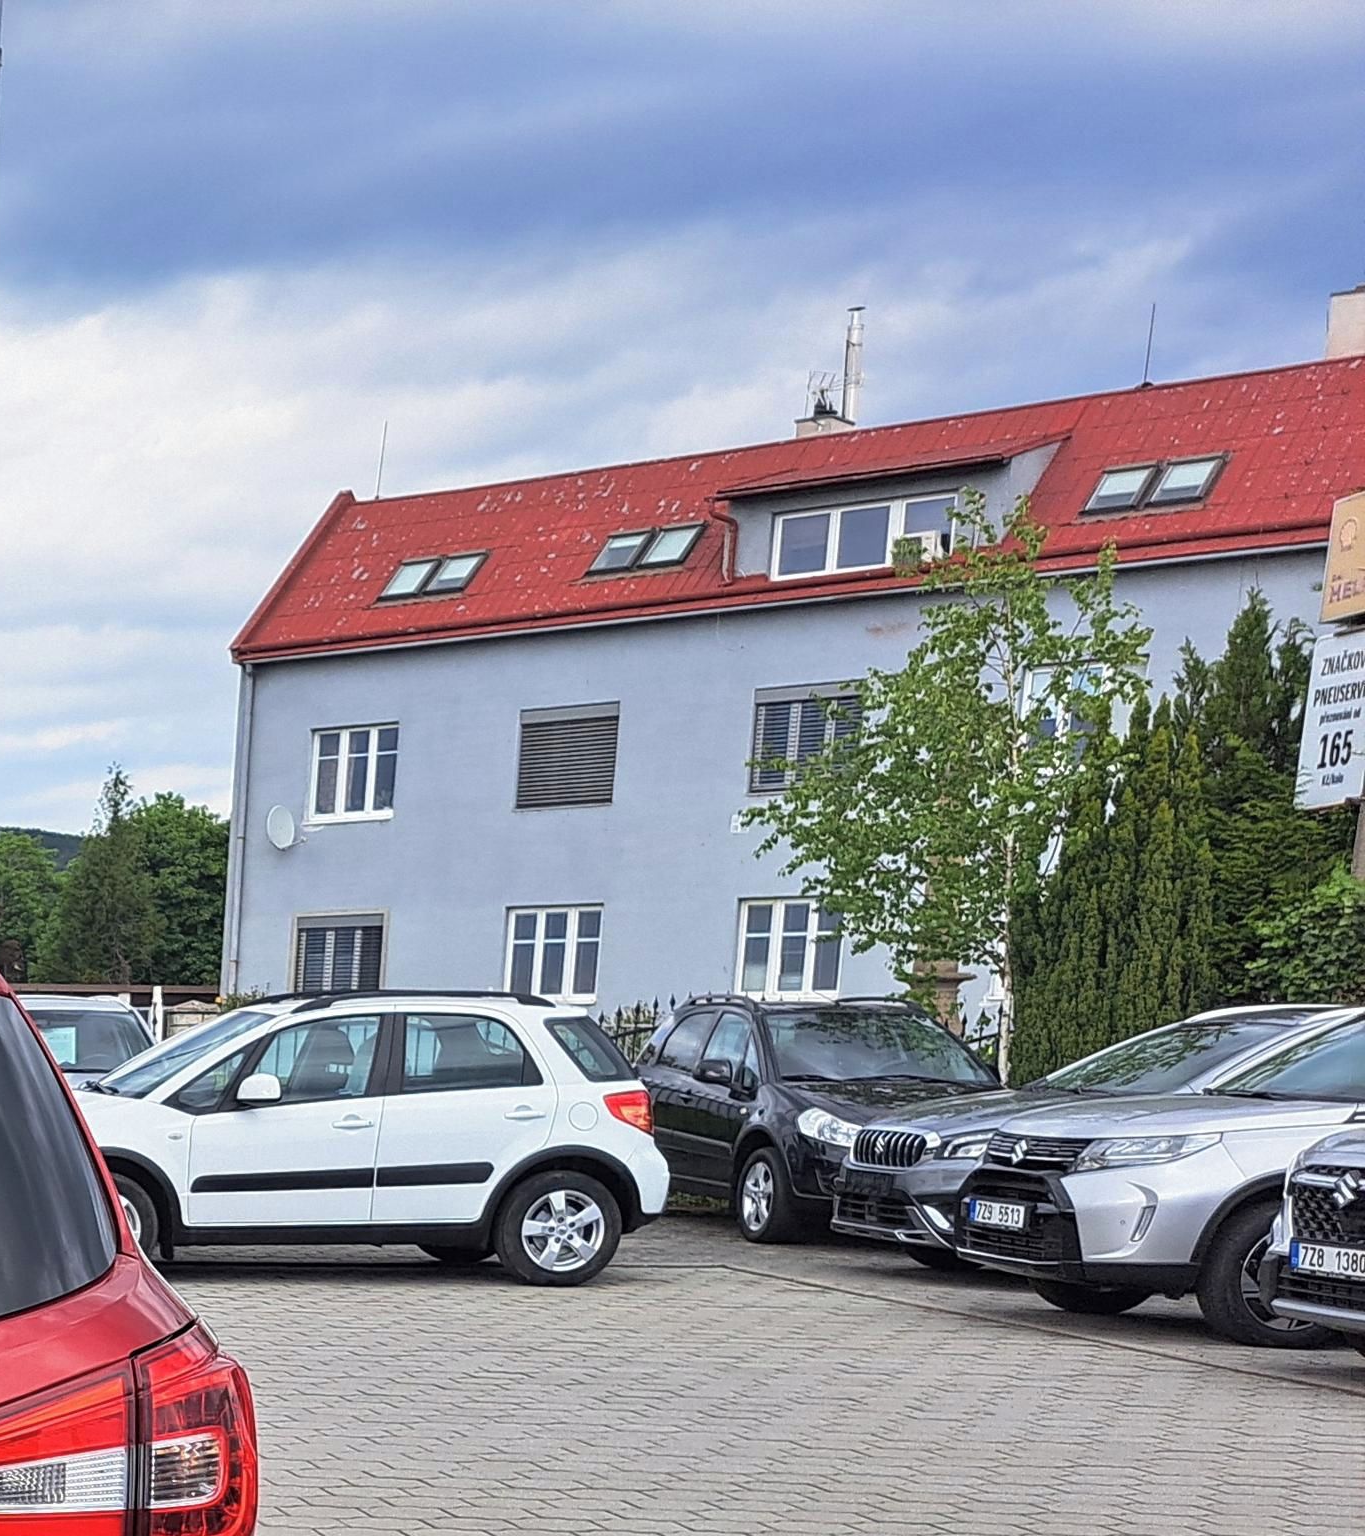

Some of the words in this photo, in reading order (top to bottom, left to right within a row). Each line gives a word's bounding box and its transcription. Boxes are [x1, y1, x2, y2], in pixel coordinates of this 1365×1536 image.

[1317, 729, 1354, 769] 165
[977, 1203, 993, 1221] 7Z9
[999, 1205, 1021, 1225] 5513
[1301, 1246, 1325, 1268] 7Z8
[1335, 1250, 1365, 1274] 1380
